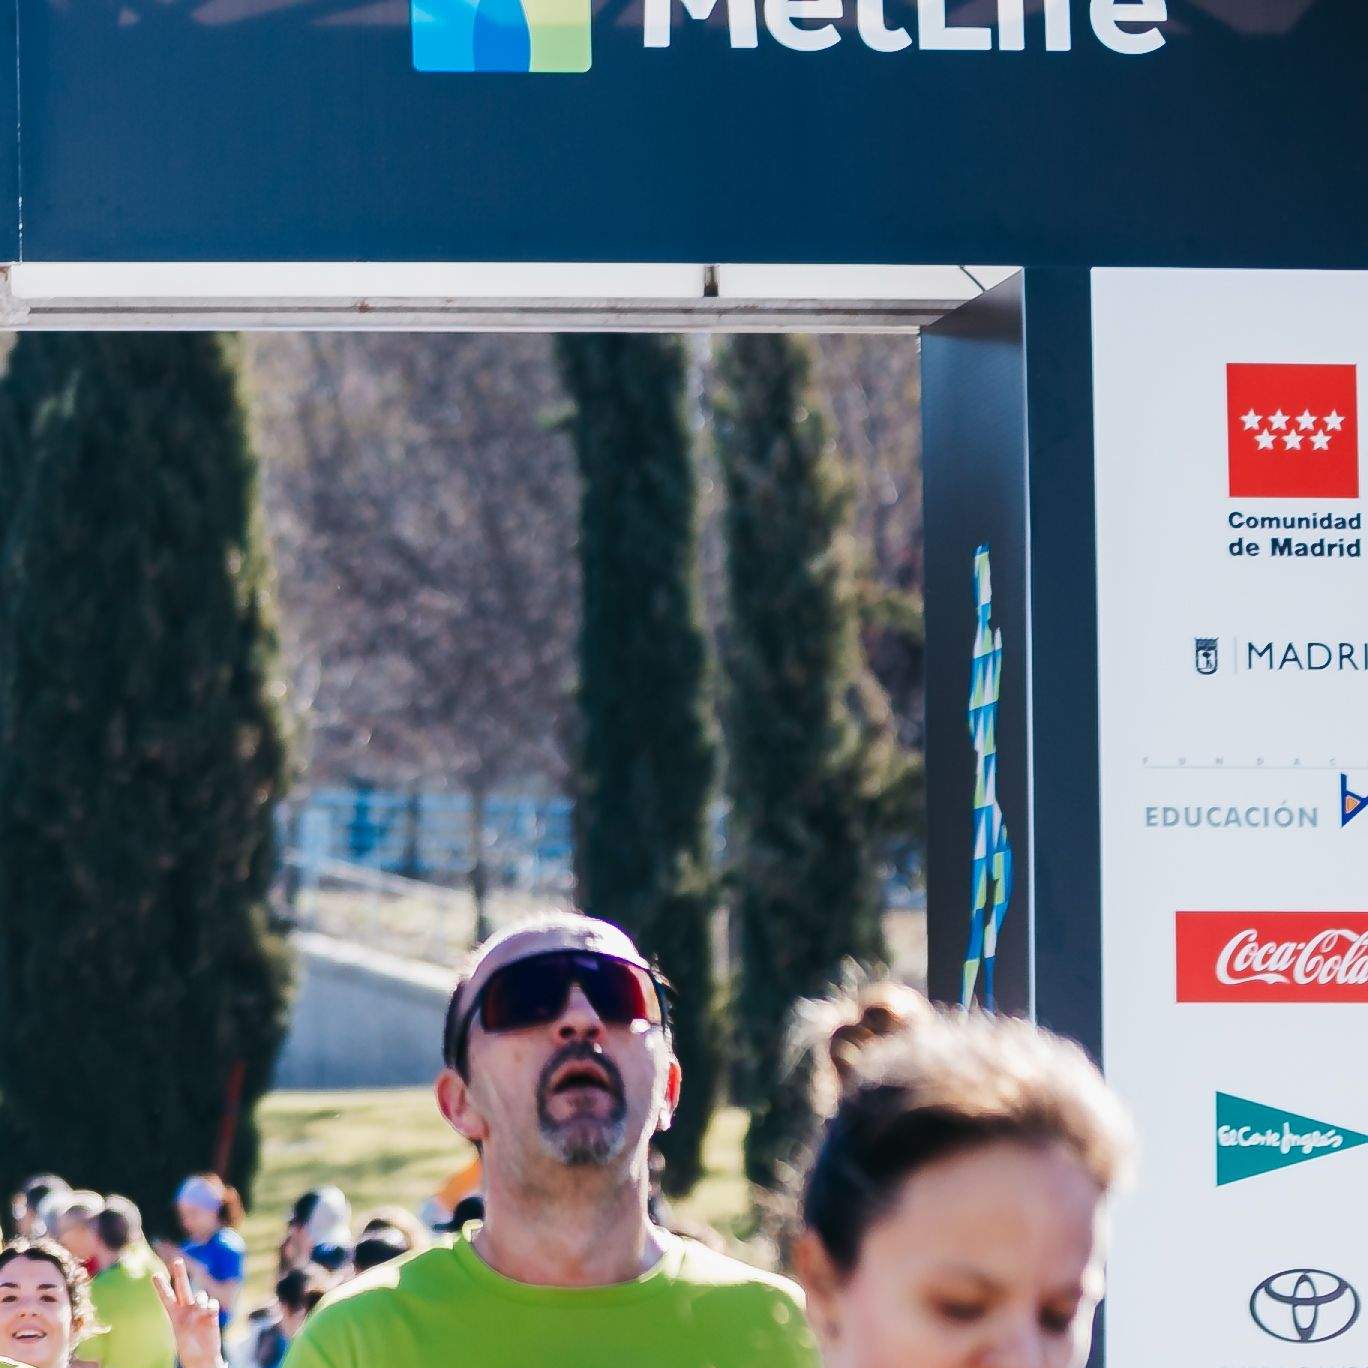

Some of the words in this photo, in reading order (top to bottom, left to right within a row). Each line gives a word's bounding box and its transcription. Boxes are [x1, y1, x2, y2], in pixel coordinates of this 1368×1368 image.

[1228, 511, 1362, 530] Comunidad
[1229, 537, 1260, 557] de
[1270, 537, 1361, 558] Madrid
[1145, 799, 1318, 828] EDUCACIÓN
